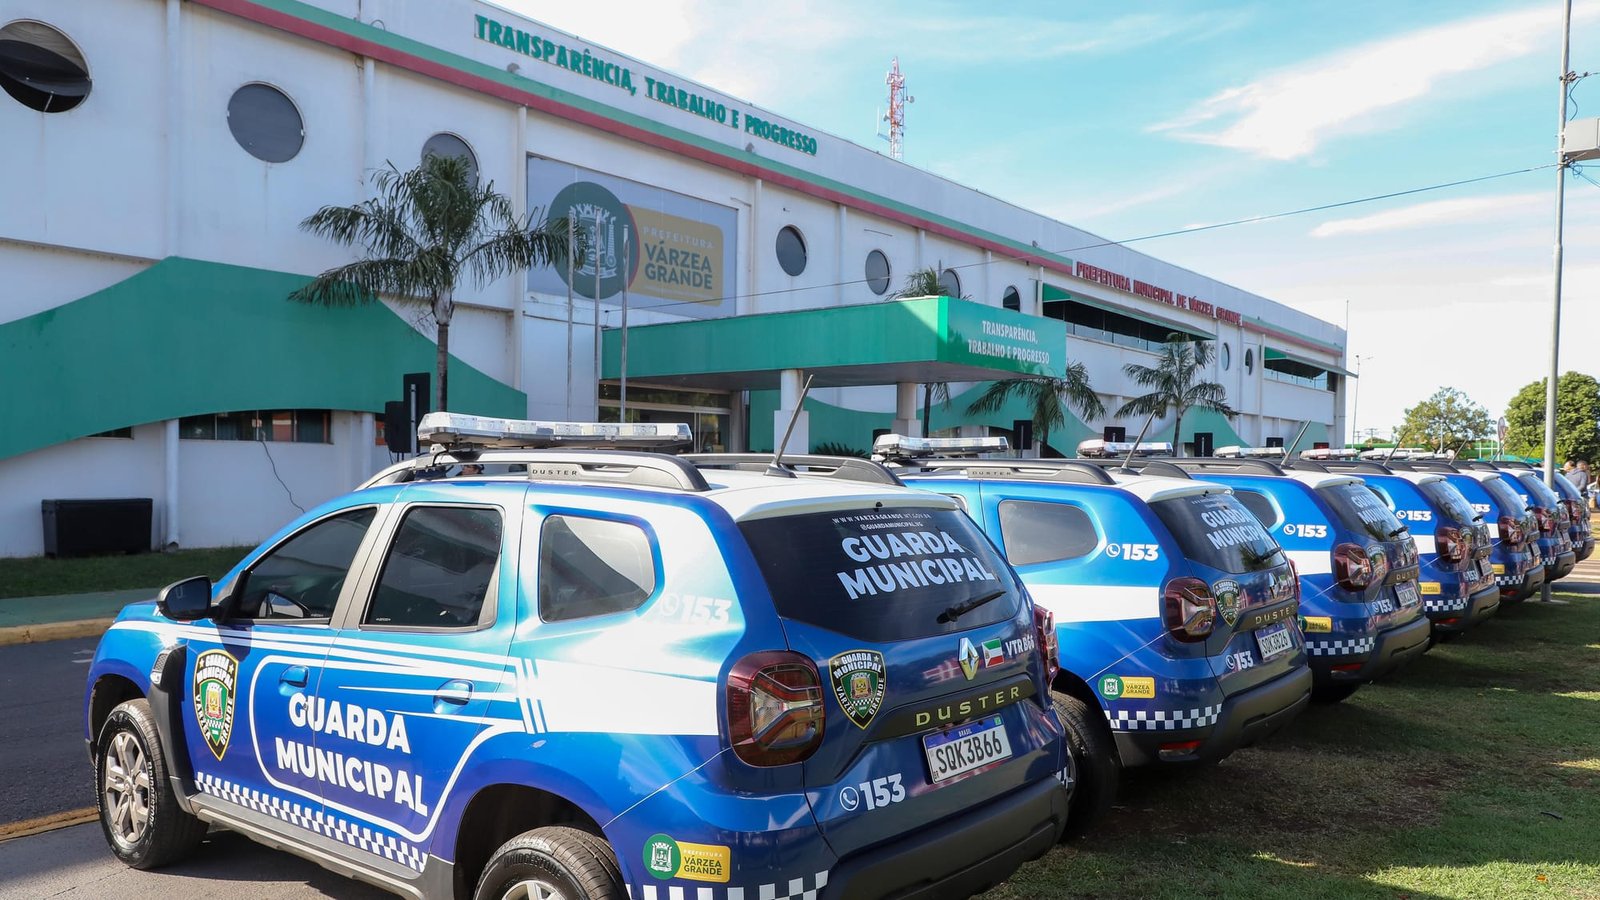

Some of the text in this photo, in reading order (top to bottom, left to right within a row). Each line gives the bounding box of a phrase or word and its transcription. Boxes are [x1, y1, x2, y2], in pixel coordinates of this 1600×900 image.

[475, 14, 818, 156] TRANSPARÊNCIA, TRABALHO E PROGRESSO
[642, 226, 714, 249] PREFEITURA
[644, 241, 712, 273] VÁRZEA
[644, 264, 713, 290] GRANDE
[1077, 261, 1242, 326] PREFEITURA MUNICIPAL DE VÁRZEA GRANDE
[981, 320, 1038, 344] TRANSPARÊNCIA,
[967, 339, 1050, 365] TRABALHO E PROGRESSO
[531, 468, 578, 476] DUSTER
[1201, 508, 1252, 528] GUARDA
[1406, 511, 1432, 521] 153
[1296, 524, 1328, 538] 153
[841, 530, 965, 563] GUARDA
[1121, 543, 1159, 561] 153
[836, 557, 996, 600] MUNICIPAL
[683, 594, 733, 625] 153
[1377, 599, 1393, 613] 153
[205, 654, 230, 670] GUARDA
[833, 662, 882, 679] MUNICIPAL
[841, 653, 872, 665] GUARDA
[1234, 650, 1254, 669] 153
[196, 666, 234, 691] MUNICIPAL
[836, 685, 857, 718] VARZEA
[868, 677, 885, 715] GRANDE
[915, 685, 1021, 727] DUSTER
[220, 696, 233, 746] GRANDE
[288, 692, 411, 754] GUARDA
[958, 728, 973, 737] BRASIL
[935, 730, 1003, 773] SQK3B66
[275, 737, 428, 817] MUNICIPAL
[859, 773, 906, 810] 153
[684, 855, 722, 868] VÁRZEA
[684, 865, 723, 876] GRANDE
